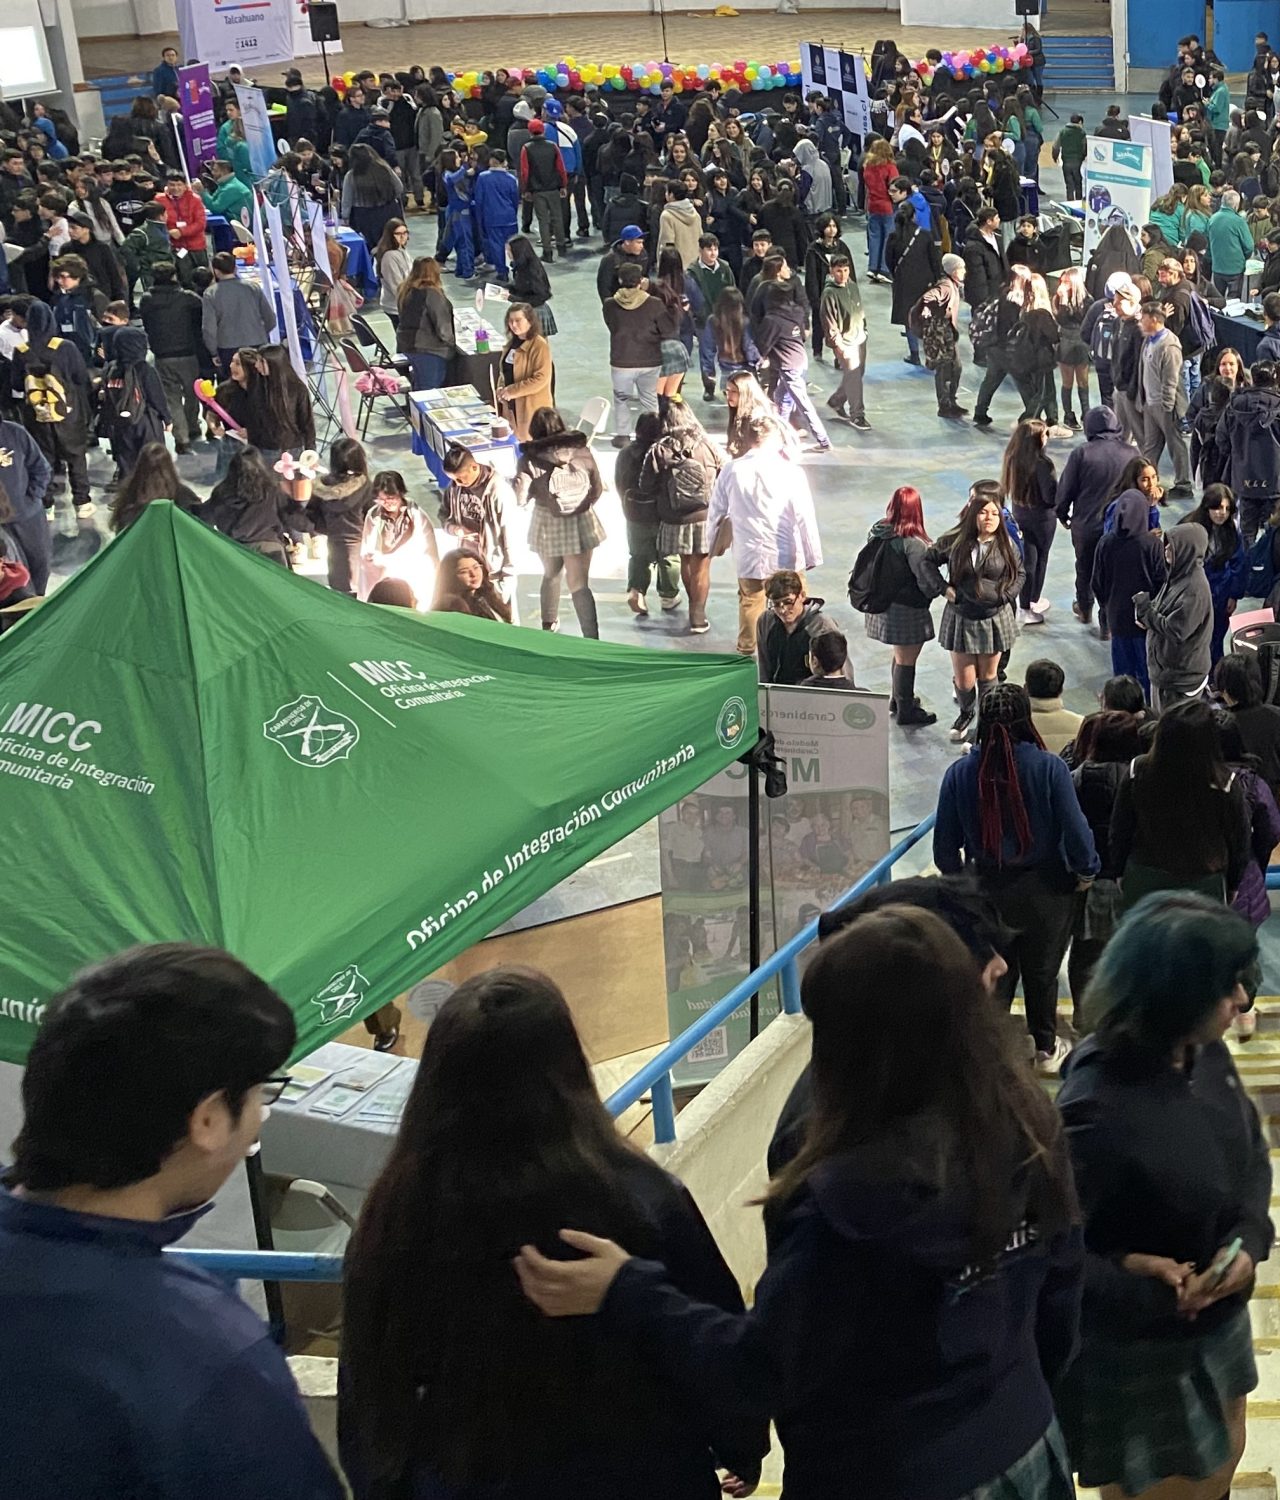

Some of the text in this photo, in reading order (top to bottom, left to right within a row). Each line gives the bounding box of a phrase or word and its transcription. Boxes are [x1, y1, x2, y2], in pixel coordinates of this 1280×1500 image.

[223, 13, 265, 25] Talcahuano
[240, 38, 258, 48] 1412
[349, 660, 427, 686] MICC
[379, 681, 426, 698] Oficina
[1, 702, 102, 752] MICC
[0, 737, 156, 795] ficina de Integración
[0, 759, 74, 790] munitaria
[481, 869, 505, 895] de
[504, 803, 602, 875] Integración
[600, 743, 697, 812] Comunitaria
